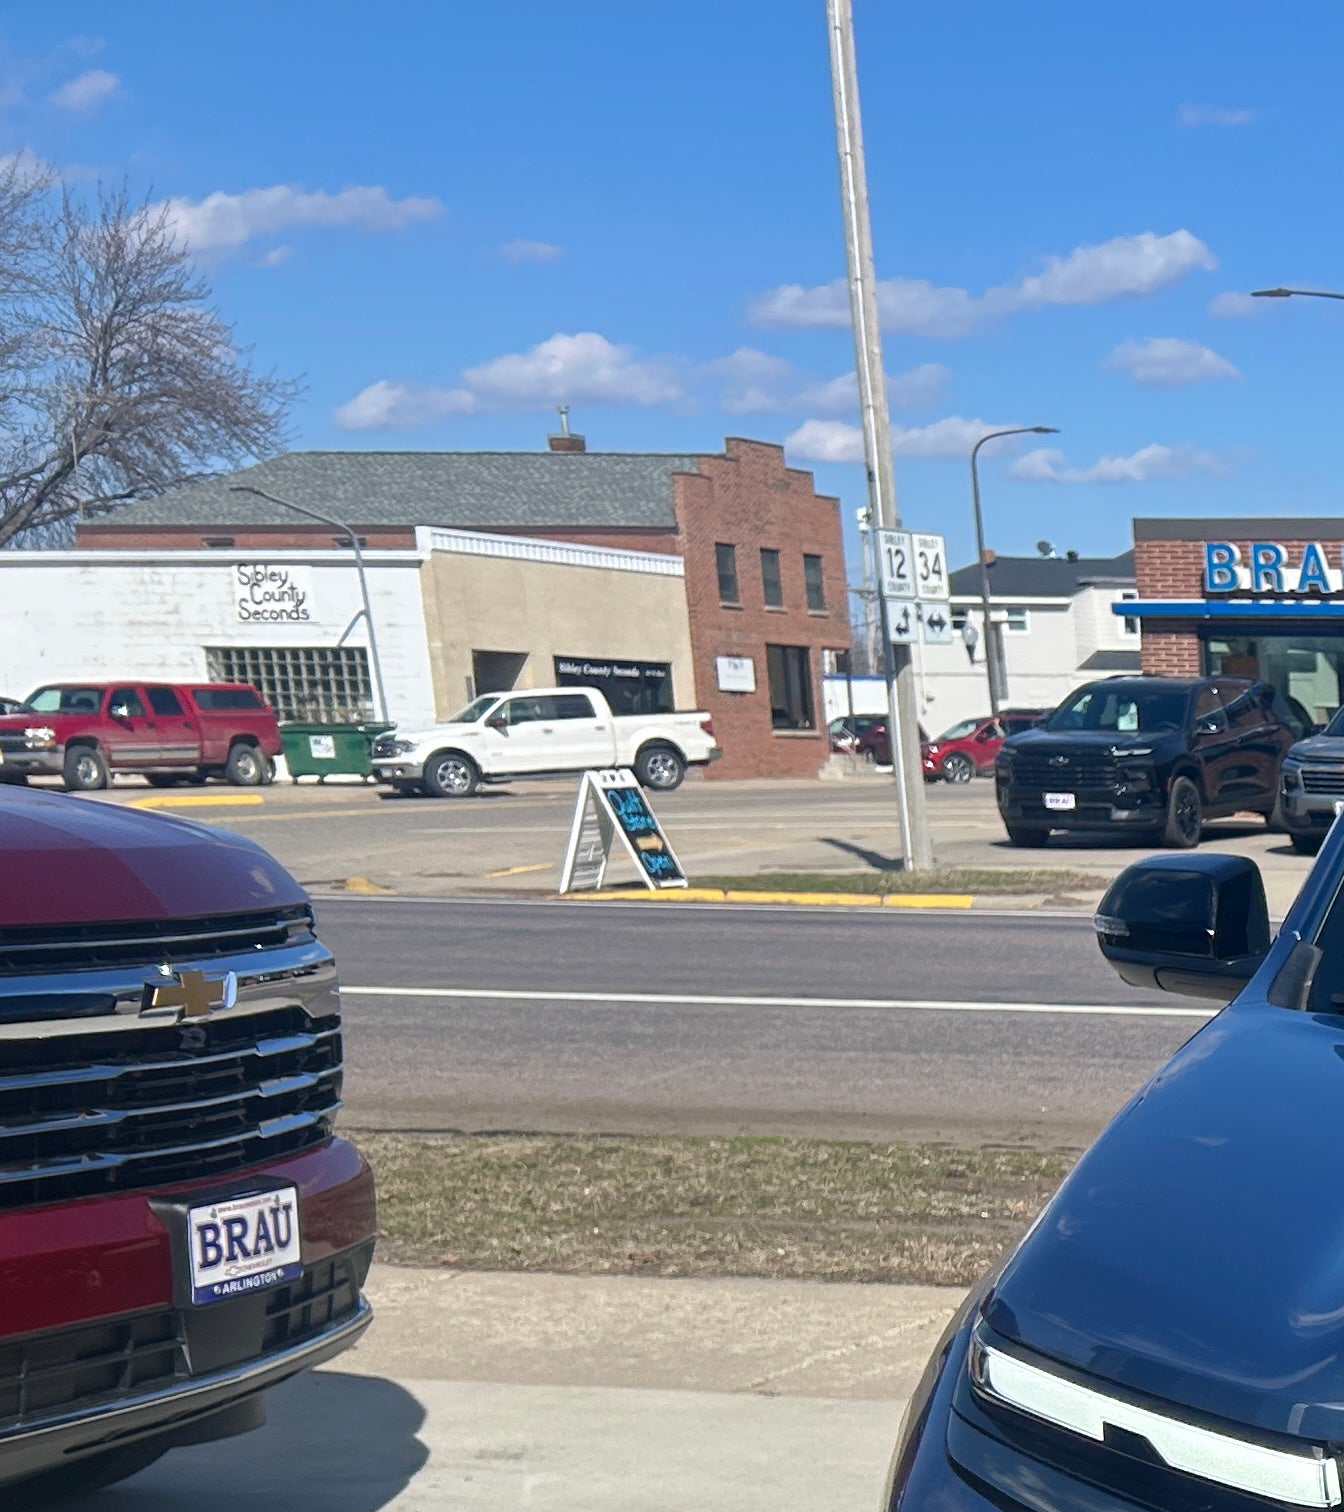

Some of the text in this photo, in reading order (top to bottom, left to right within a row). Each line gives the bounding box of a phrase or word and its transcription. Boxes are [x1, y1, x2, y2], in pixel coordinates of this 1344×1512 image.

[237, 563, 288, 589] Sibley
[887, 547, 906, 579] 12
[919, 551, 942, 581] 34
[250, 581, 306, 608] County
[238, 597, 310, 620] Seconds
[196, 1202, 292, 1271] BRAU
[222, 1271, 277, 1294] ARLINGTON
